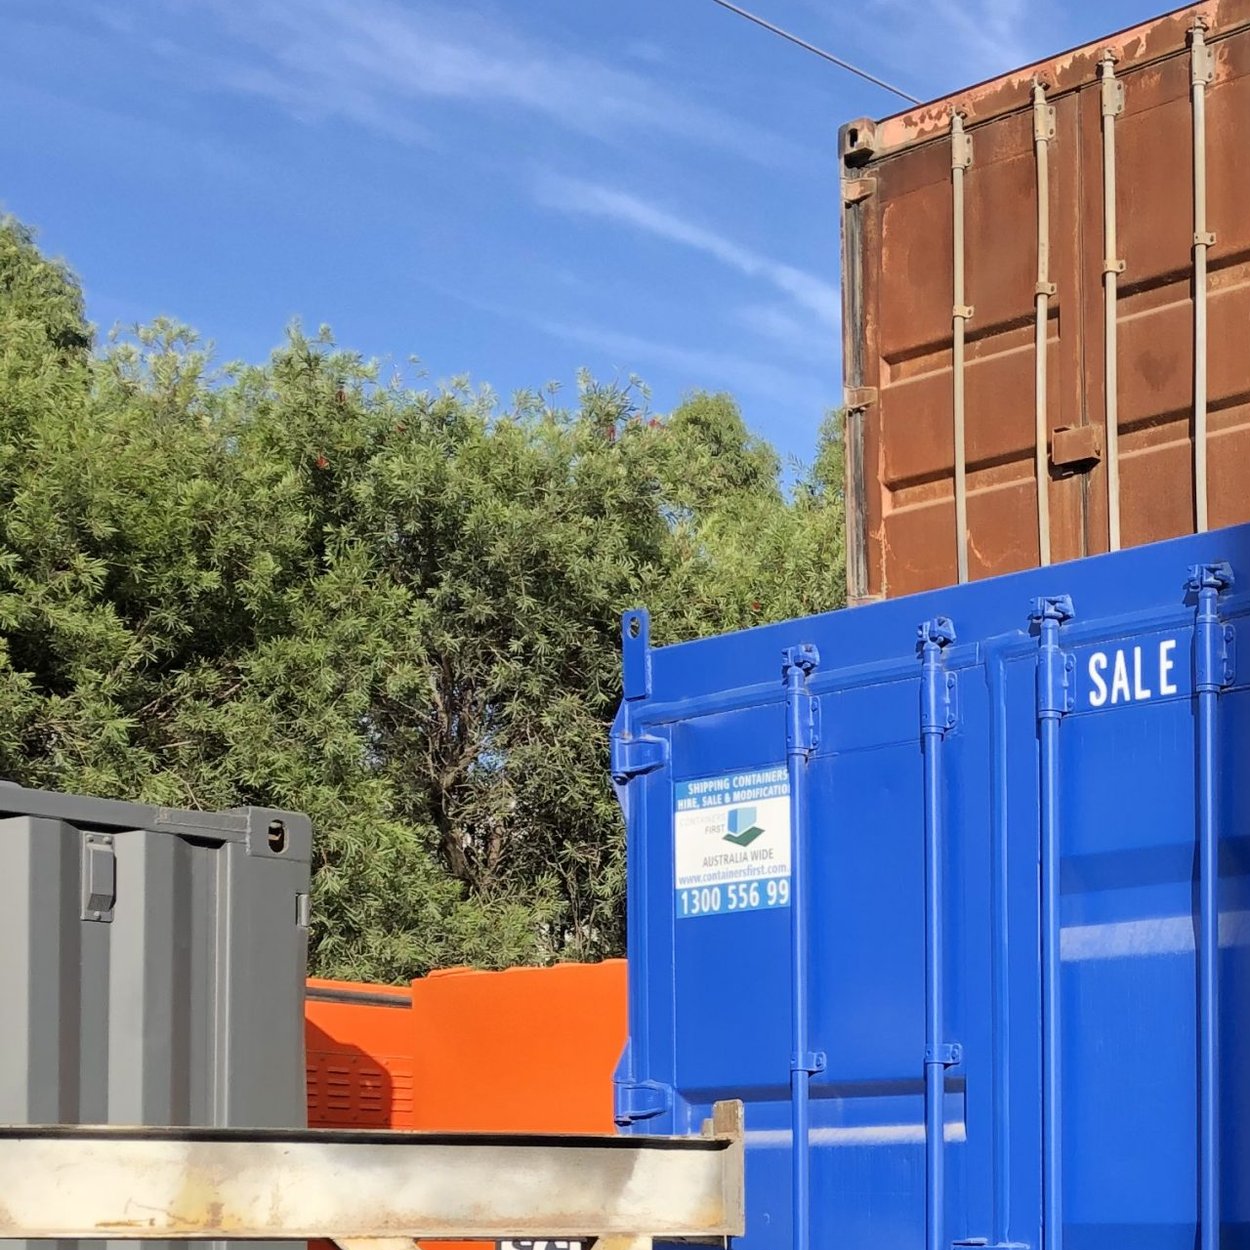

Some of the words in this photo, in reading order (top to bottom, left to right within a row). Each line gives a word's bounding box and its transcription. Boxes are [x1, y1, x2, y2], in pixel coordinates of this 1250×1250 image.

[1088, 639, 1177, 707] SALE
[688, 778, 730, 795] SHIPPING
[732, 768, 788, 787] CONTAINERS
[677, 799, 699, 811] HIRE,
[702, 796, 722, 807] SALE
[725, 794, 731, 803] &
[732, 783, 790, 802] MODIFICATIO
[705, 823, 725, 835] FIRST
[702, 852, 748, 869] AUSTRALIA
[751, 848, 774, 861] WIDE
[681, 887, 721, 915] 1300
[727, 881, 760, 909] 556
